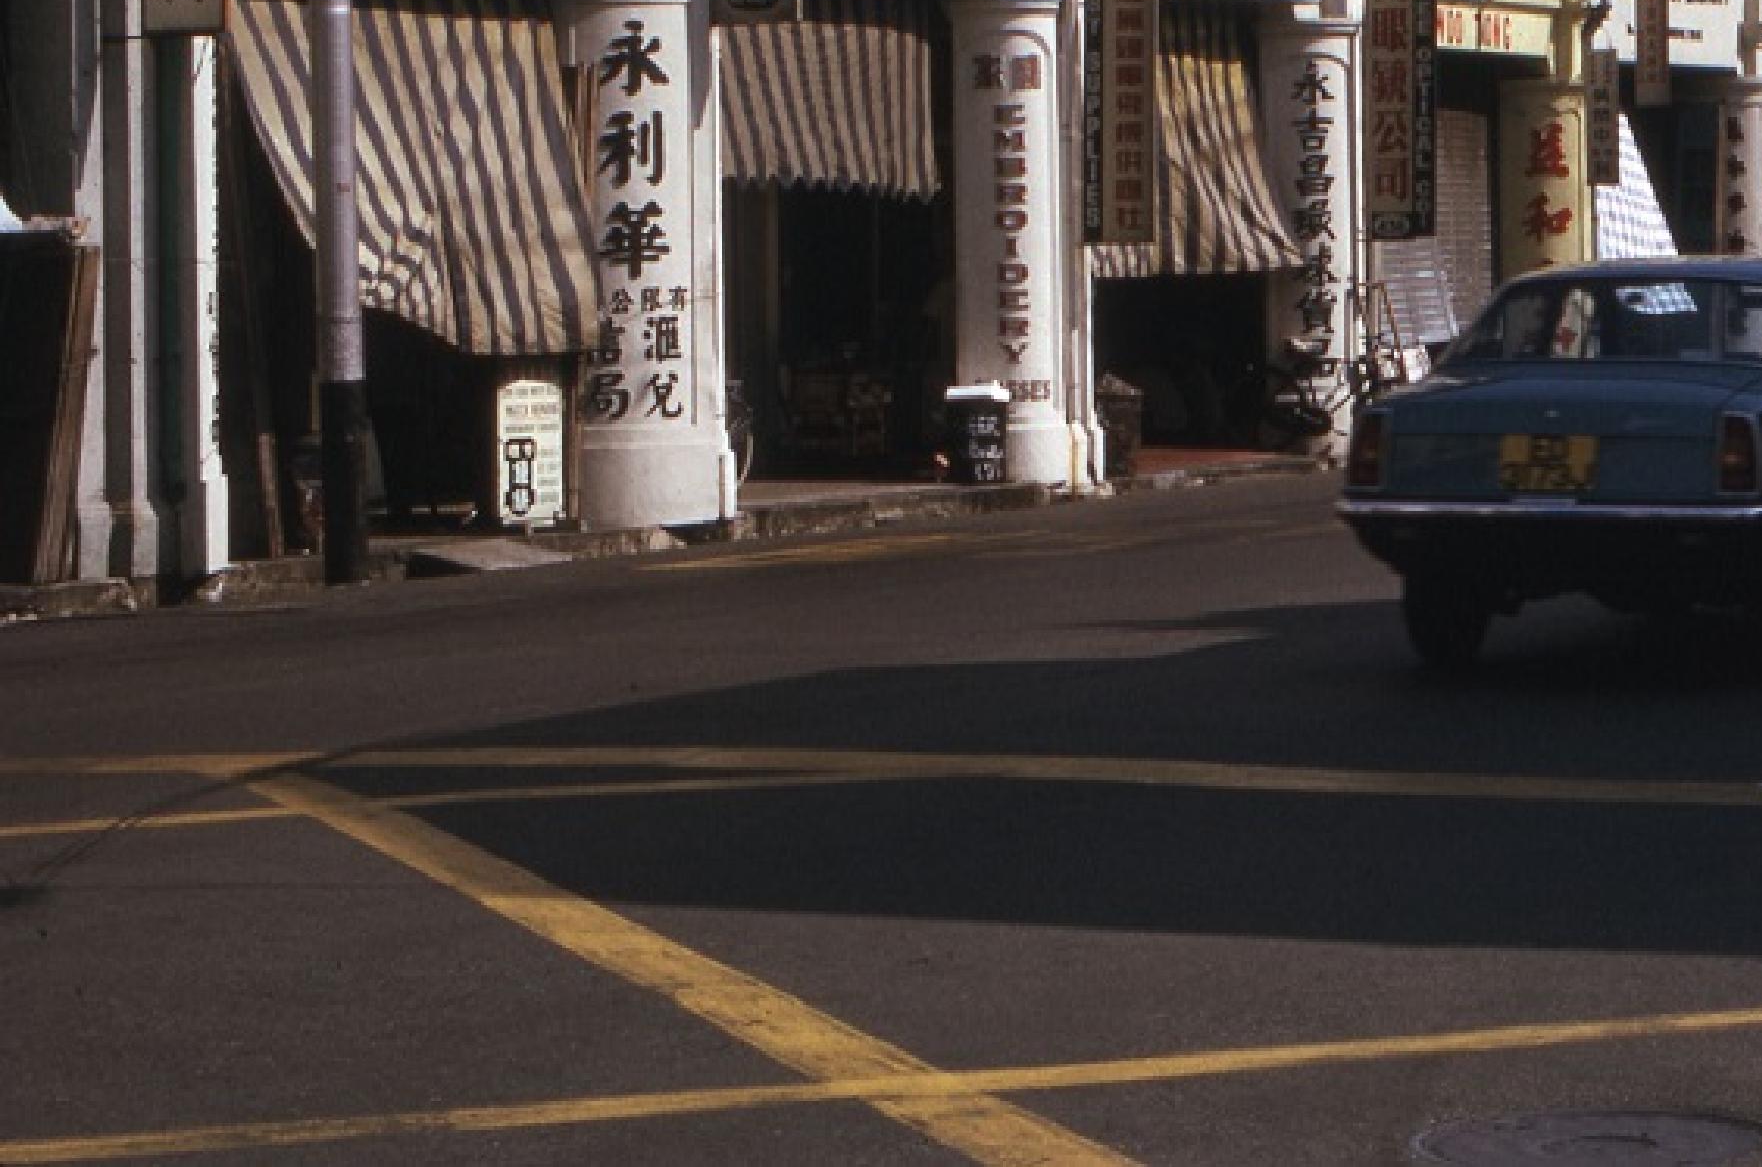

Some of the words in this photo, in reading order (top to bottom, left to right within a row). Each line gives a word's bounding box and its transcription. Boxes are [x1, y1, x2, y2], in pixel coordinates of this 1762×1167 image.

[599, 19, 671, 280] 永利華
[1416, 47, 1433, 168] OPTICAL
[608, 285, 689, 313] 有限公
[994, 103, 1031, 365] EMBROIDERY
